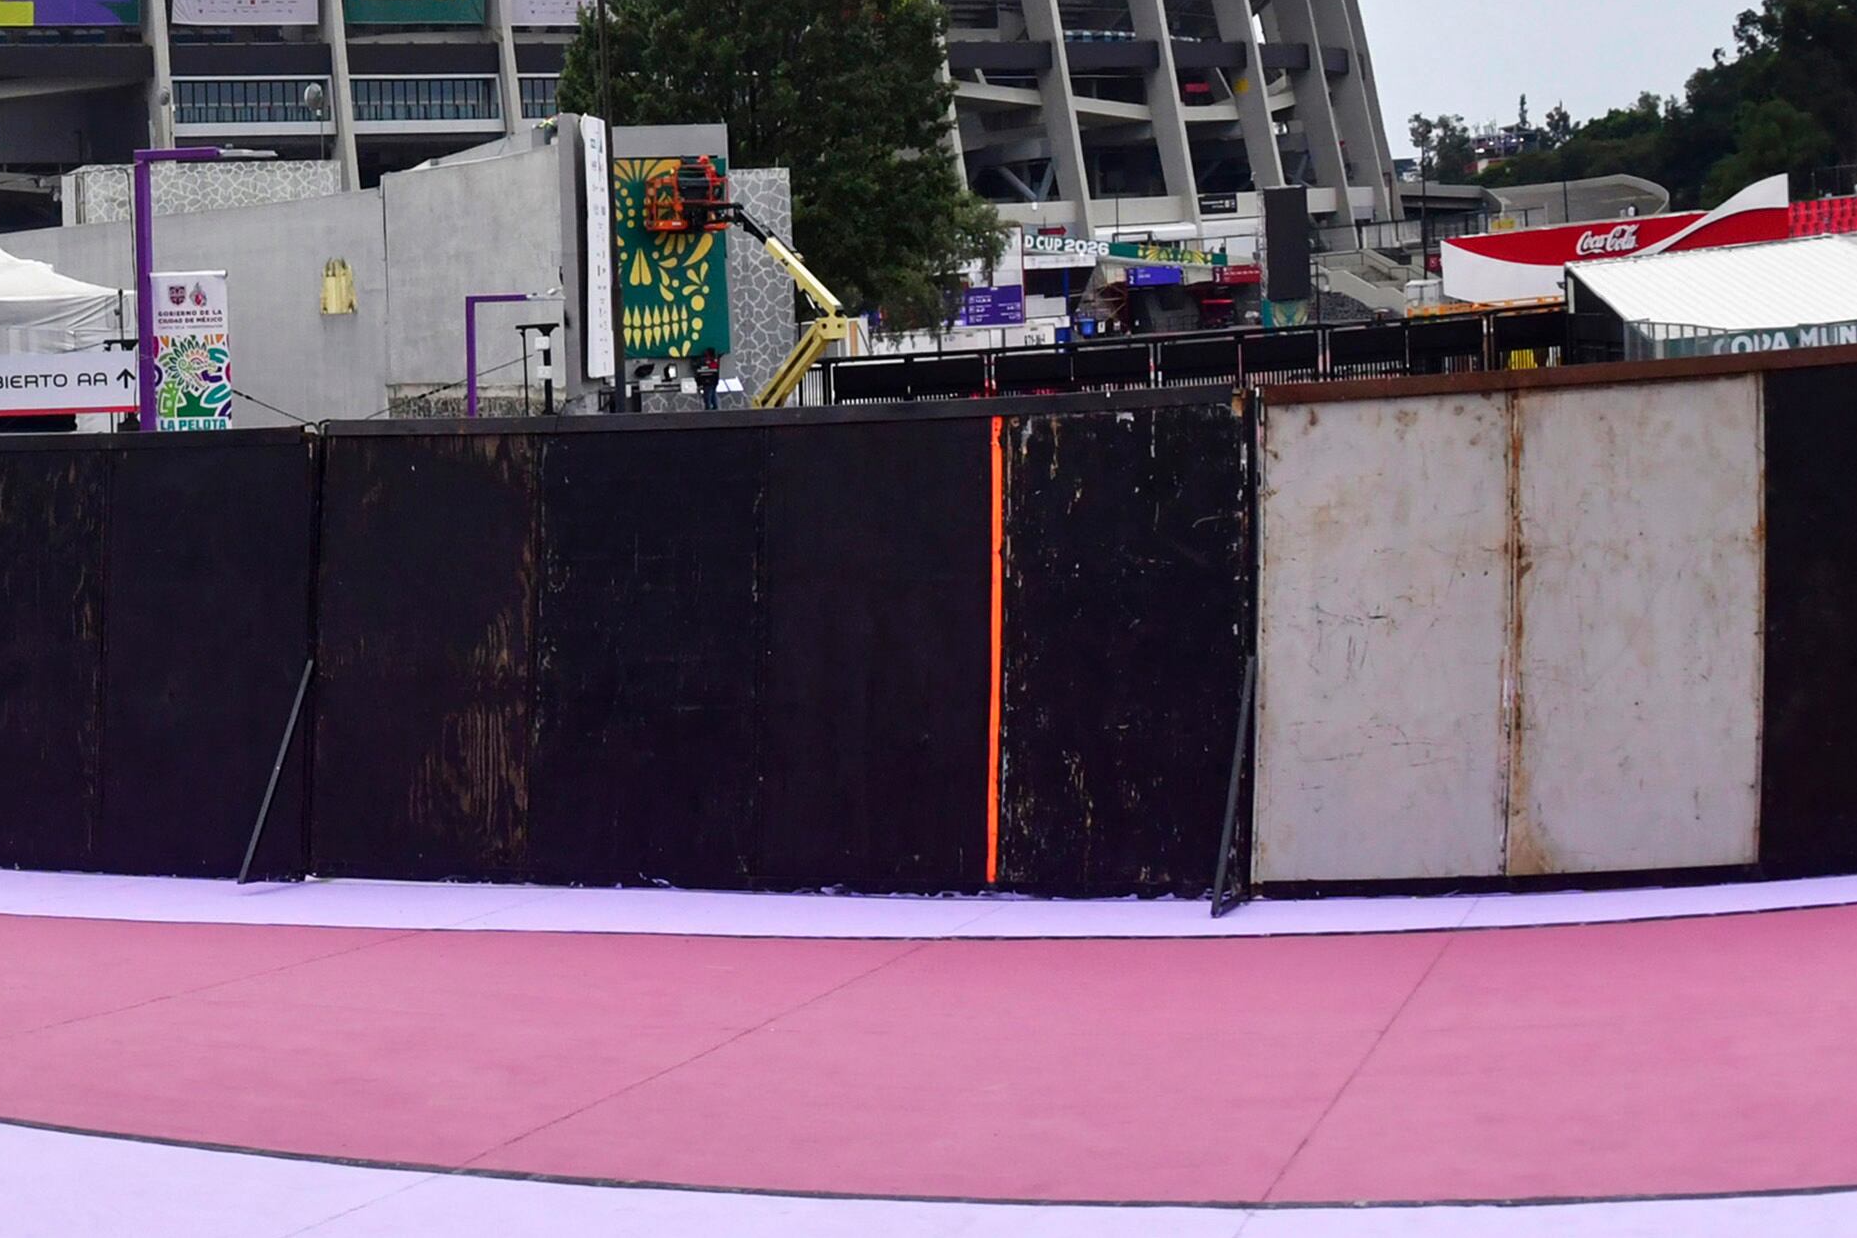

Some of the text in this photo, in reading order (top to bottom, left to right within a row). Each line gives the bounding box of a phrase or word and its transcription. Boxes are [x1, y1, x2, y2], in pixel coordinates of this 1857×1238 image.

[1036, 237, 1062, 250] CUP
[1064, 240, 1109, 255] 2026
[1576, 223, 1640, 255] Coca-Cola
[77, 372, 108, 387] AA
[160, 419, 227, 431] LA PELOTA
